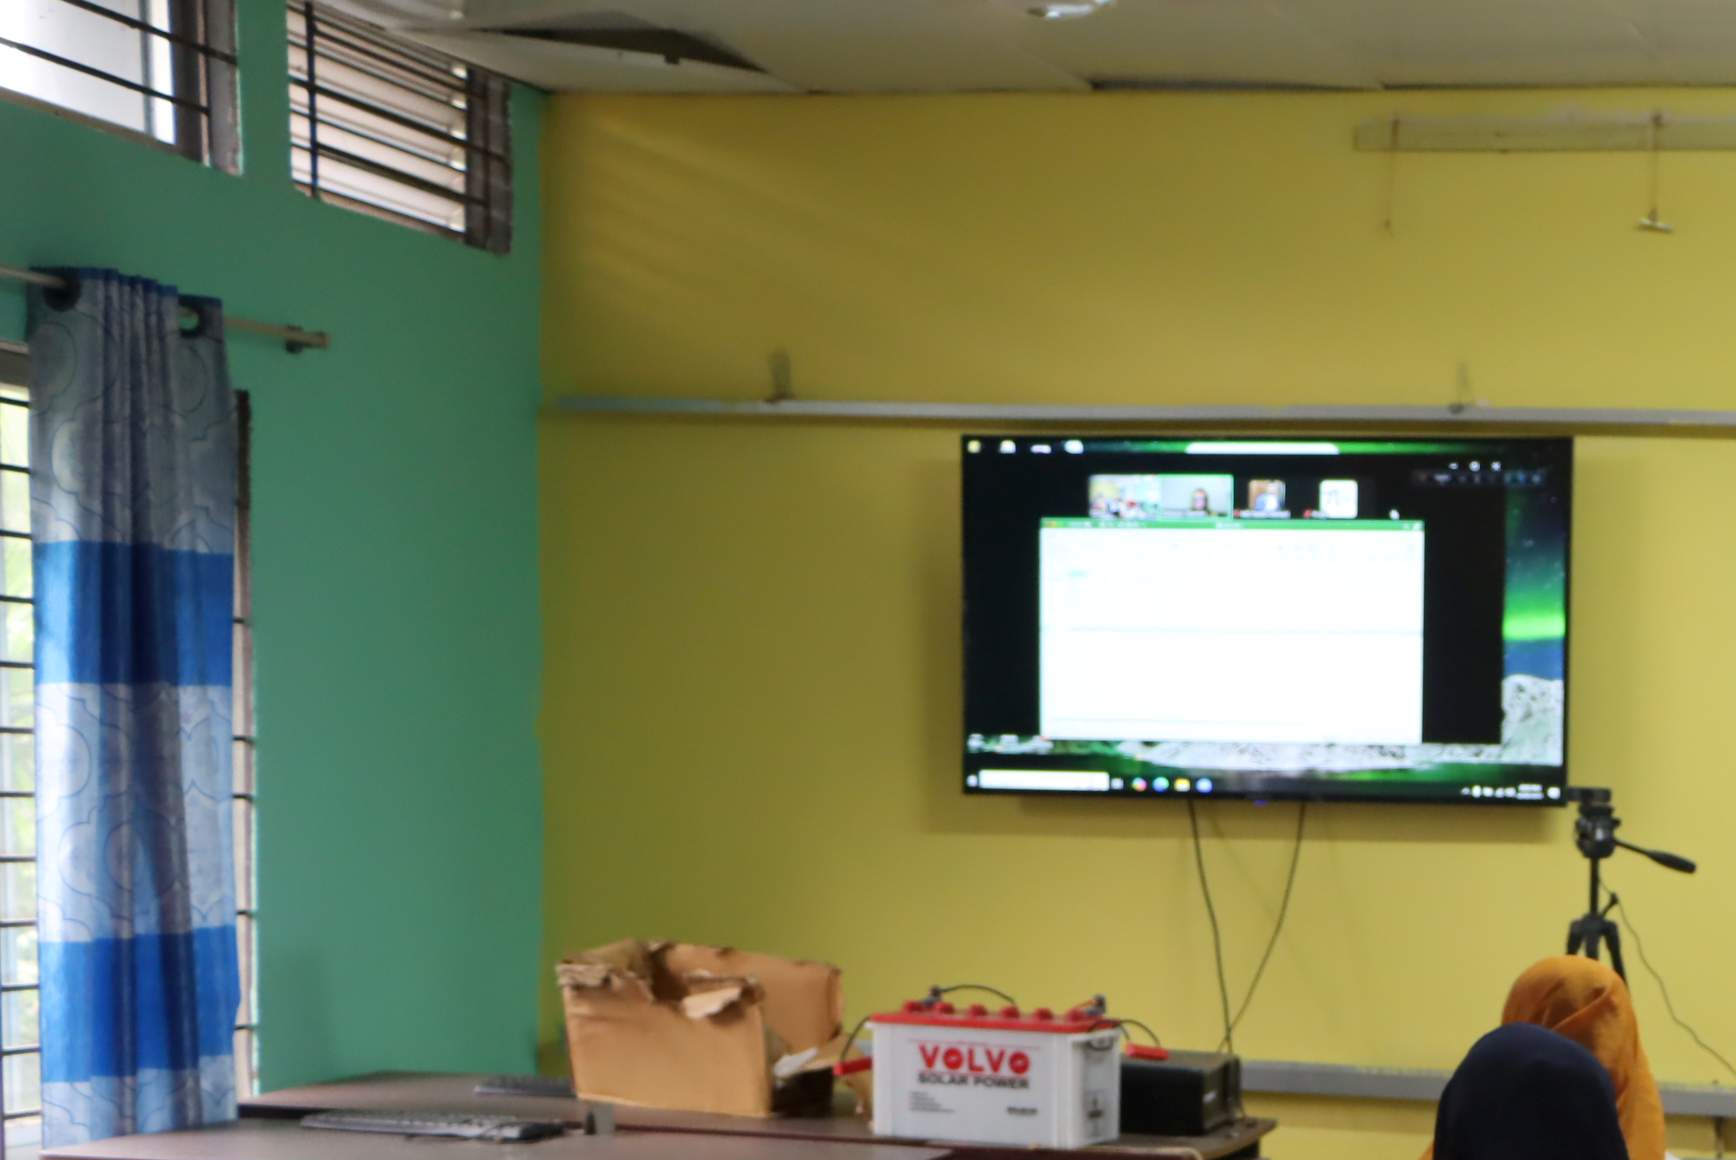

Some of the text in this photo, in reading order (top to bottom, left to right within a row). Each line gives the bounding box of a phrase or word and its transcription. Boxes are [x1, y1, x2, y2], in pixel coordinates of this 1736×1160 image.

[918, 1043, 1031, 1074] VOLVO
[918, 1073, 1030, 1089] SOLAR POWER
